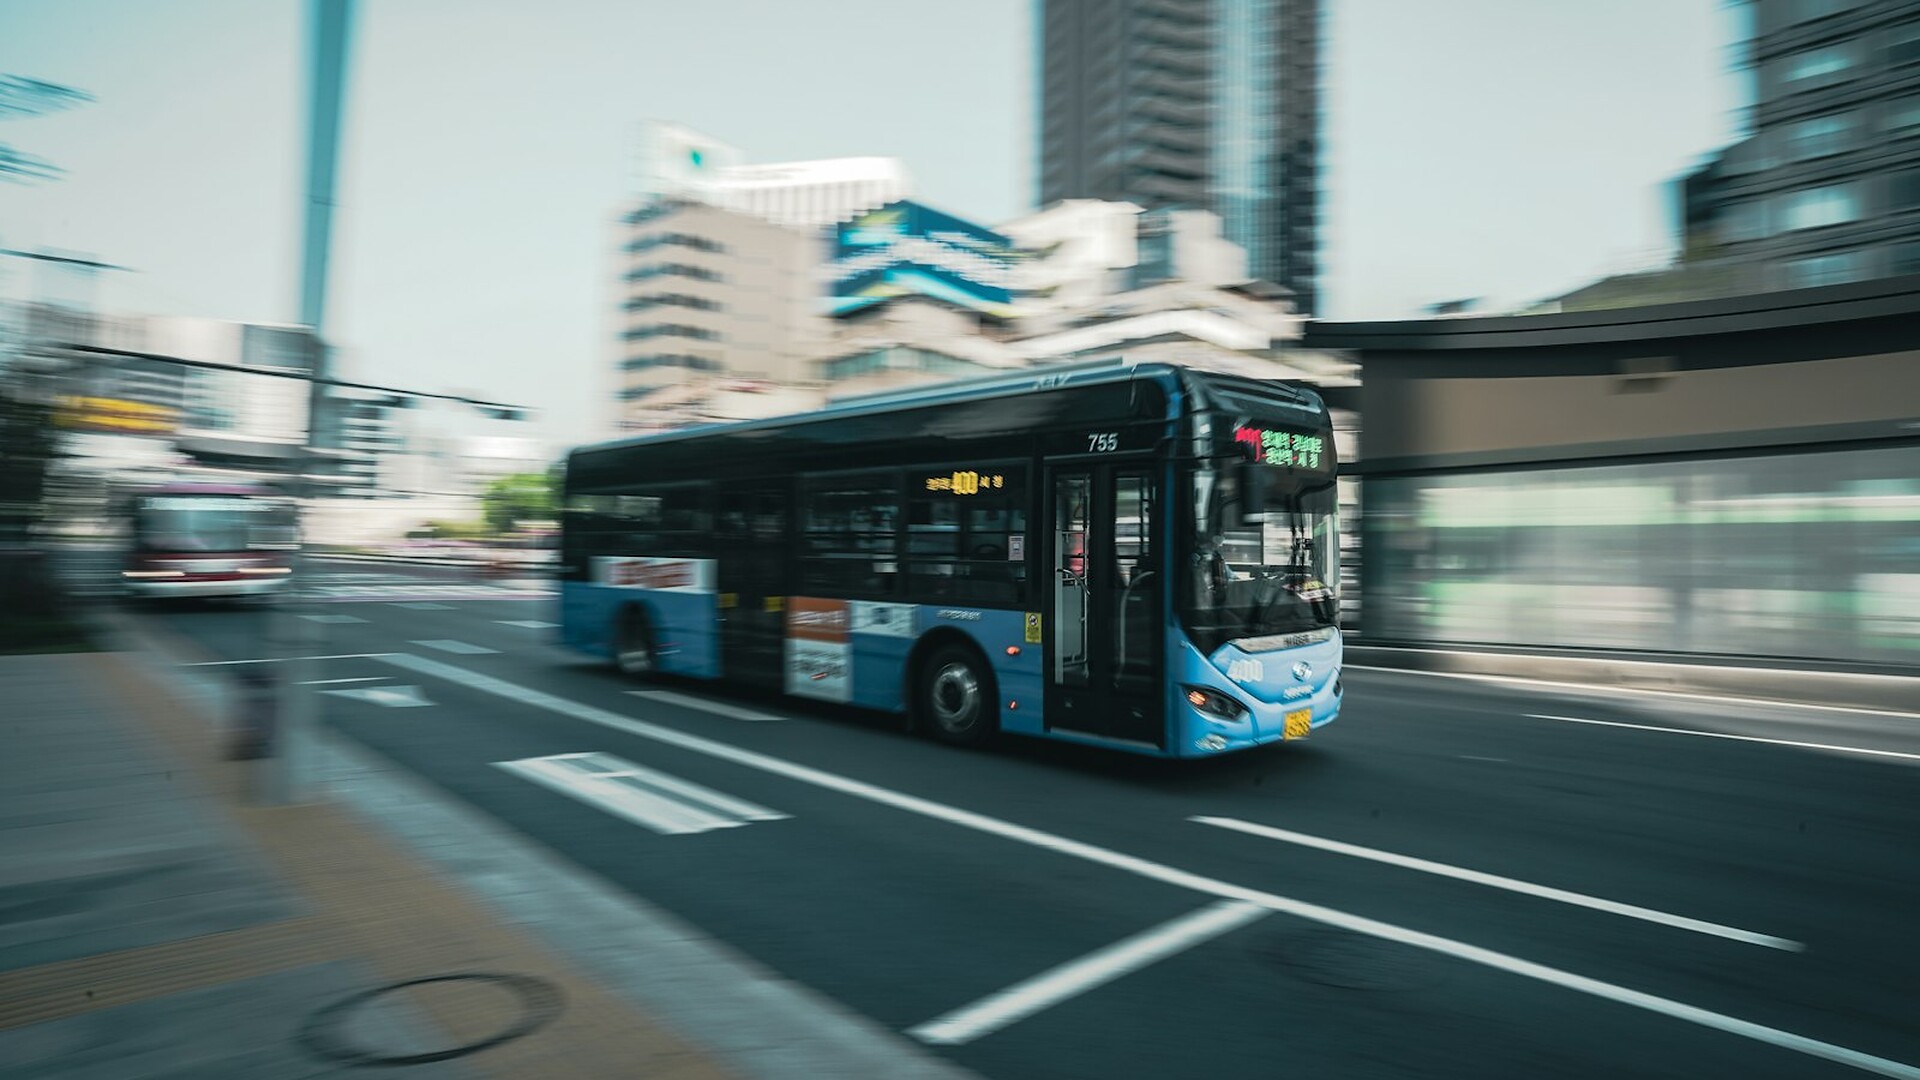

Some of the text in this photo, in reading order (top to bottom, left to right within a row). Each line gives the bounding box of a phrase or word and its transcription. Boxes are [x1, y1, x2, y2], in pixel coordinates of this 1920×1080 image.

[1088, 433, 1119, 452] 755
[951, 470, 979, 495] 400
[1226, 659, 1264, 683] 400
